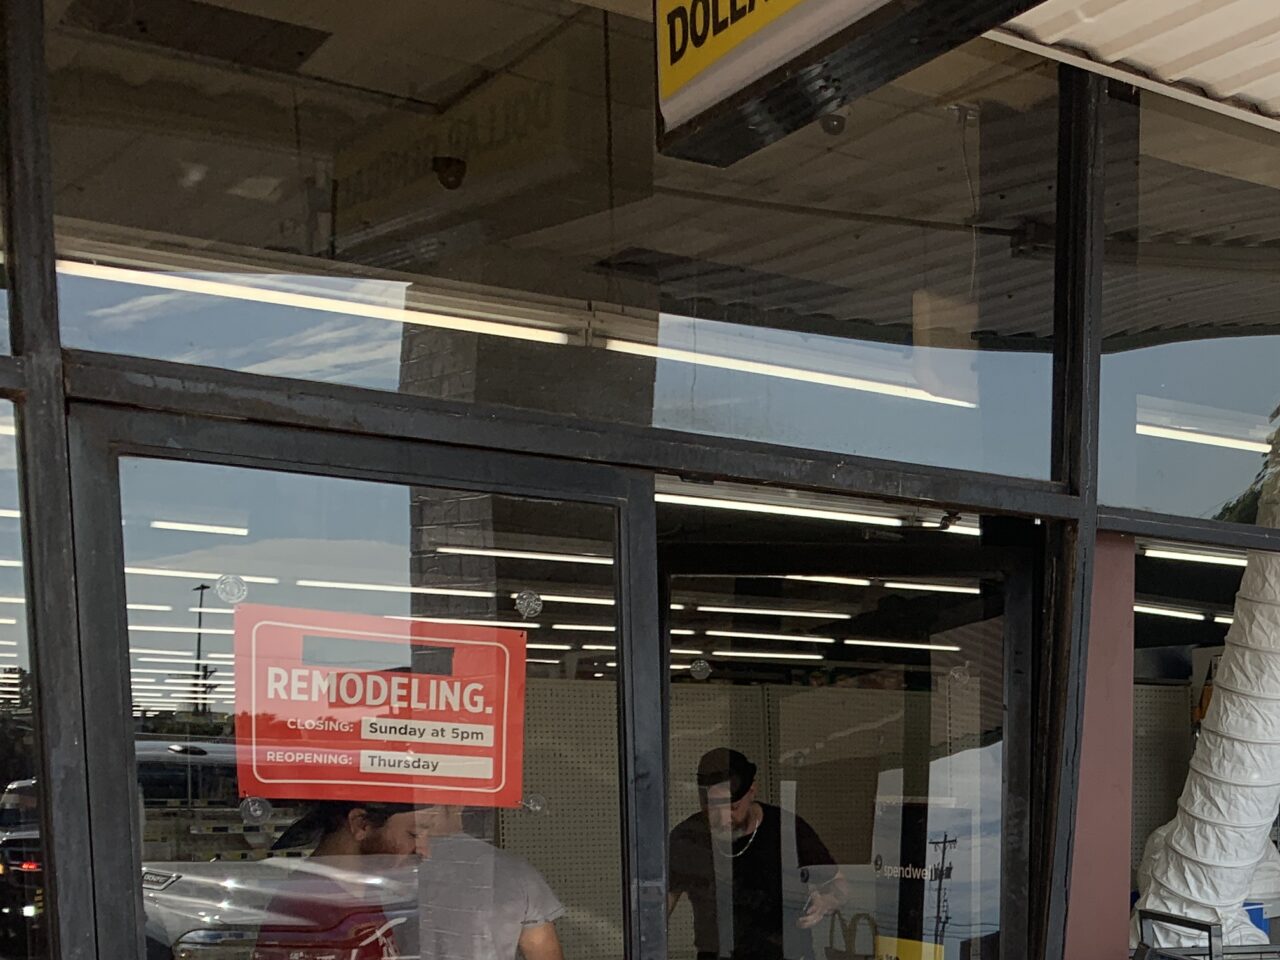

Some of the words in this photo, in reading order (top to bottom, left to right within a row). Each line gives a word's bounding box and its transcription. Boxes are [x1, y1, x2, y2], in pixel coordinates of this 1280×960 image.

[267, 666, 493, 714] REMODELING.
[286, 718, 354, 733] CLOSING:
[368, 722, 426, 740] Sunday
[431, 727, 445, 739] at
[451, 728, 484, 743] 5pm
[266, 751, 352, 766] REOPENING:
[368, 755, 439, 773] Thursday
[883, 863, 935, 881] spendwell
